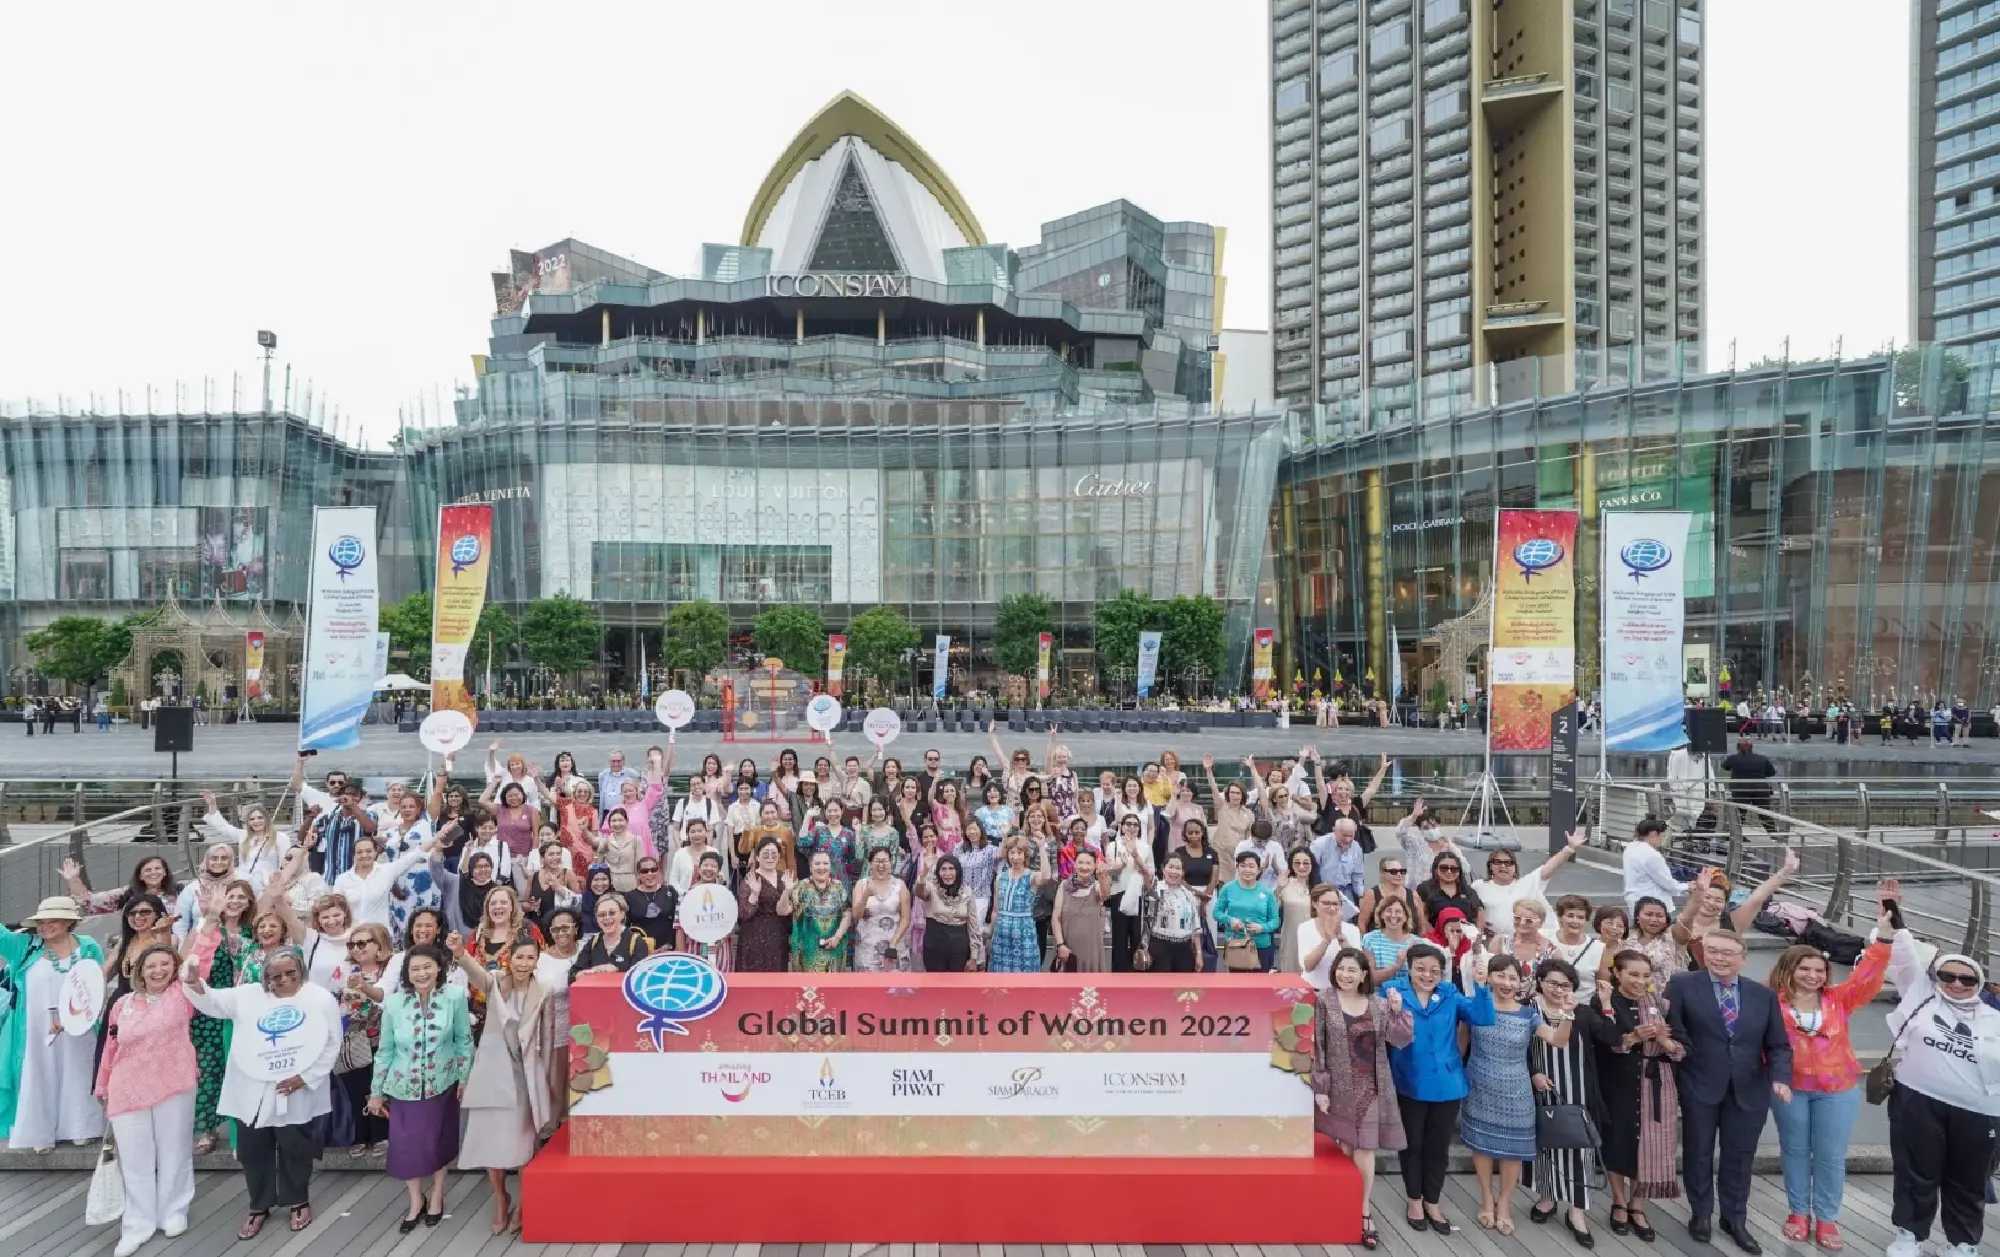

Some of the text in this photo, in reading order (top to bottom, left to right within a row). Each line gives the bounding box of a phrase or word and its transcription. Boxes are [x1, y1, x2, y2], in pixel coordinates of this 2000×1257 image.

[538, 253, 566, 275] 2022
[765, 274, 911, 297] ICONSIAM
[711, 484, 767, 499] LOUIS
[1074, 473, 1151, 497] Cartier
[484, 486, 531, 502] VENETA
[1559, 721, 1568, 734] 2
[737, 1009, 1251, 1036] Global Summit of Women 2022
[268, 1057, 296, 1071] 2022
[700, 1071, 772, 1084] THAILAND
[891, 1069, 934, 1082] SIAM
[1103, 1072, 1185, 1086] ICONSIAM
[808, 1089, 847, 1100] TCEB
[891, 1083, 945, 1096] PIWAT
